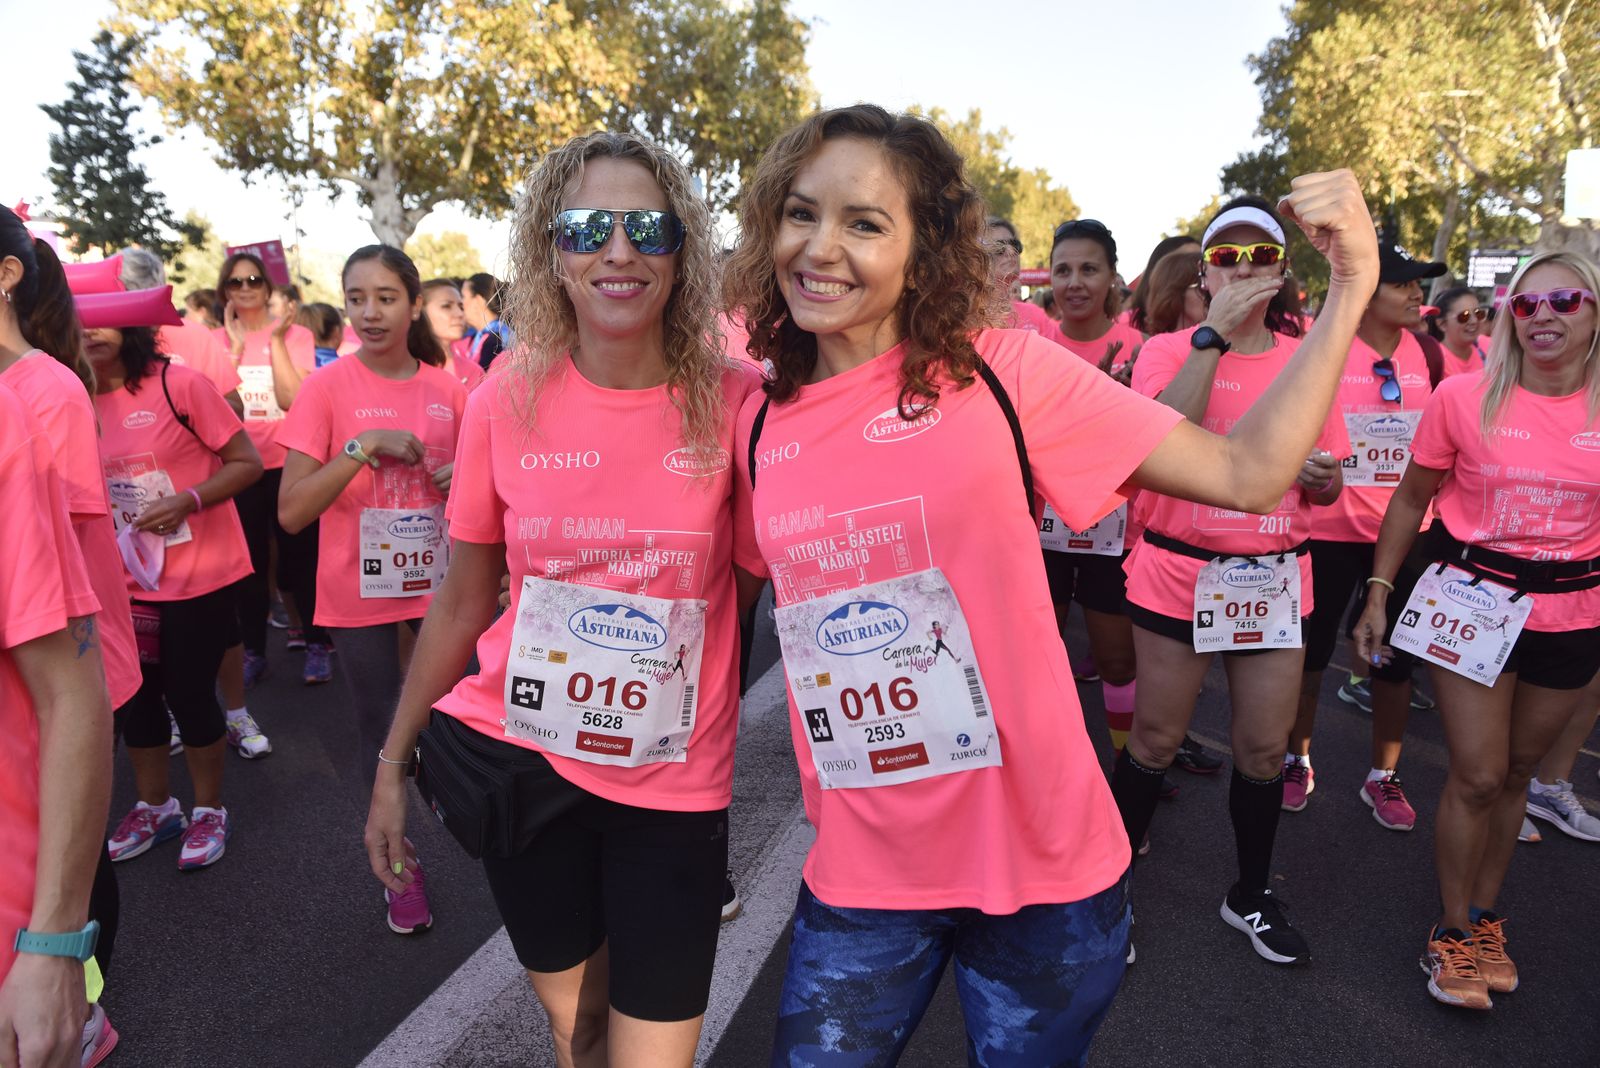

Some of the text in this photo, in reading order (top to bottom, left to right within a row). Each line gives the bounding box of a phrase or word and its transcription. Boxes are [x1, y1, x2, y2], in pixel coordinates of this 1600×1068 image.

[1214, 379, 1241, 392] SHO
[244, 392, 269, 402] 016
[355, 408, 397, 418] OYSHO
[520, 450, 600, 470] OYSHO
[755, 442, 800, 472] YSHO
[1367, 448, 1405, 461] 016
[1516, 485, 1546, 495] VITORIA
[1553, 490, 1587, 501] GASTEIZ
[1530, 496, 1562, 507] MADRID
[518, 516, 625, 539] HOY GANAN
[767, 505, 825, 540] GANAN
[1258, 516, 1292, 535] 2019
[788, 538, 838, 562] VITORIA
[849, 524, 903, 548] GASTEIZ
[393, 550, 434, 568] 016
[580, 550, 631, 563] VITORIA
[644, 550, 696, 566] GASTEIZ
[818, 548, 870, 572] MADRID
[403, 569, 425, 578] 9592
[608, 561, 659, 577] MADRID
[1226, 572, 1272, 583] ASTURIANA
[1445, 584, 1493, 609] ASTURIANA
[1225, 601, 1268, 618] 016
[575, 615, 659, 645] ASTURIANA
[824, 617, 903, 648] ASTURIANA
[1235, 621, 1257, 629] 7415
[1430, 612, 1478, 641] 016
[1198, 636, 1224, 644] OYSHO
[1395, 632, 1419, 646] OYSHO
[1433, 633, 1458, 648] 2541
[631, 653, 668, 668] Carrera
[883, 645, 922, 660] Carrera
[910, 655, 937, 674] Mujer
[649, 668, 674, 685] Mujer
[566, 672, 648, 710] 016
[840, 676, 919, 721] 016
[581, 711, 623, 730] 5628
[514, 719, 558, 740] OYSHO
[864, 722, 905, 744] 2593
[592, 740, 625, 750] Santander
[646, 747, 675, 757] ZURICH
[885, 752, 919, 766] Santander
[950, 748, 987, 761] ZURICH
[822, 759, 857, 773] OYSHO
